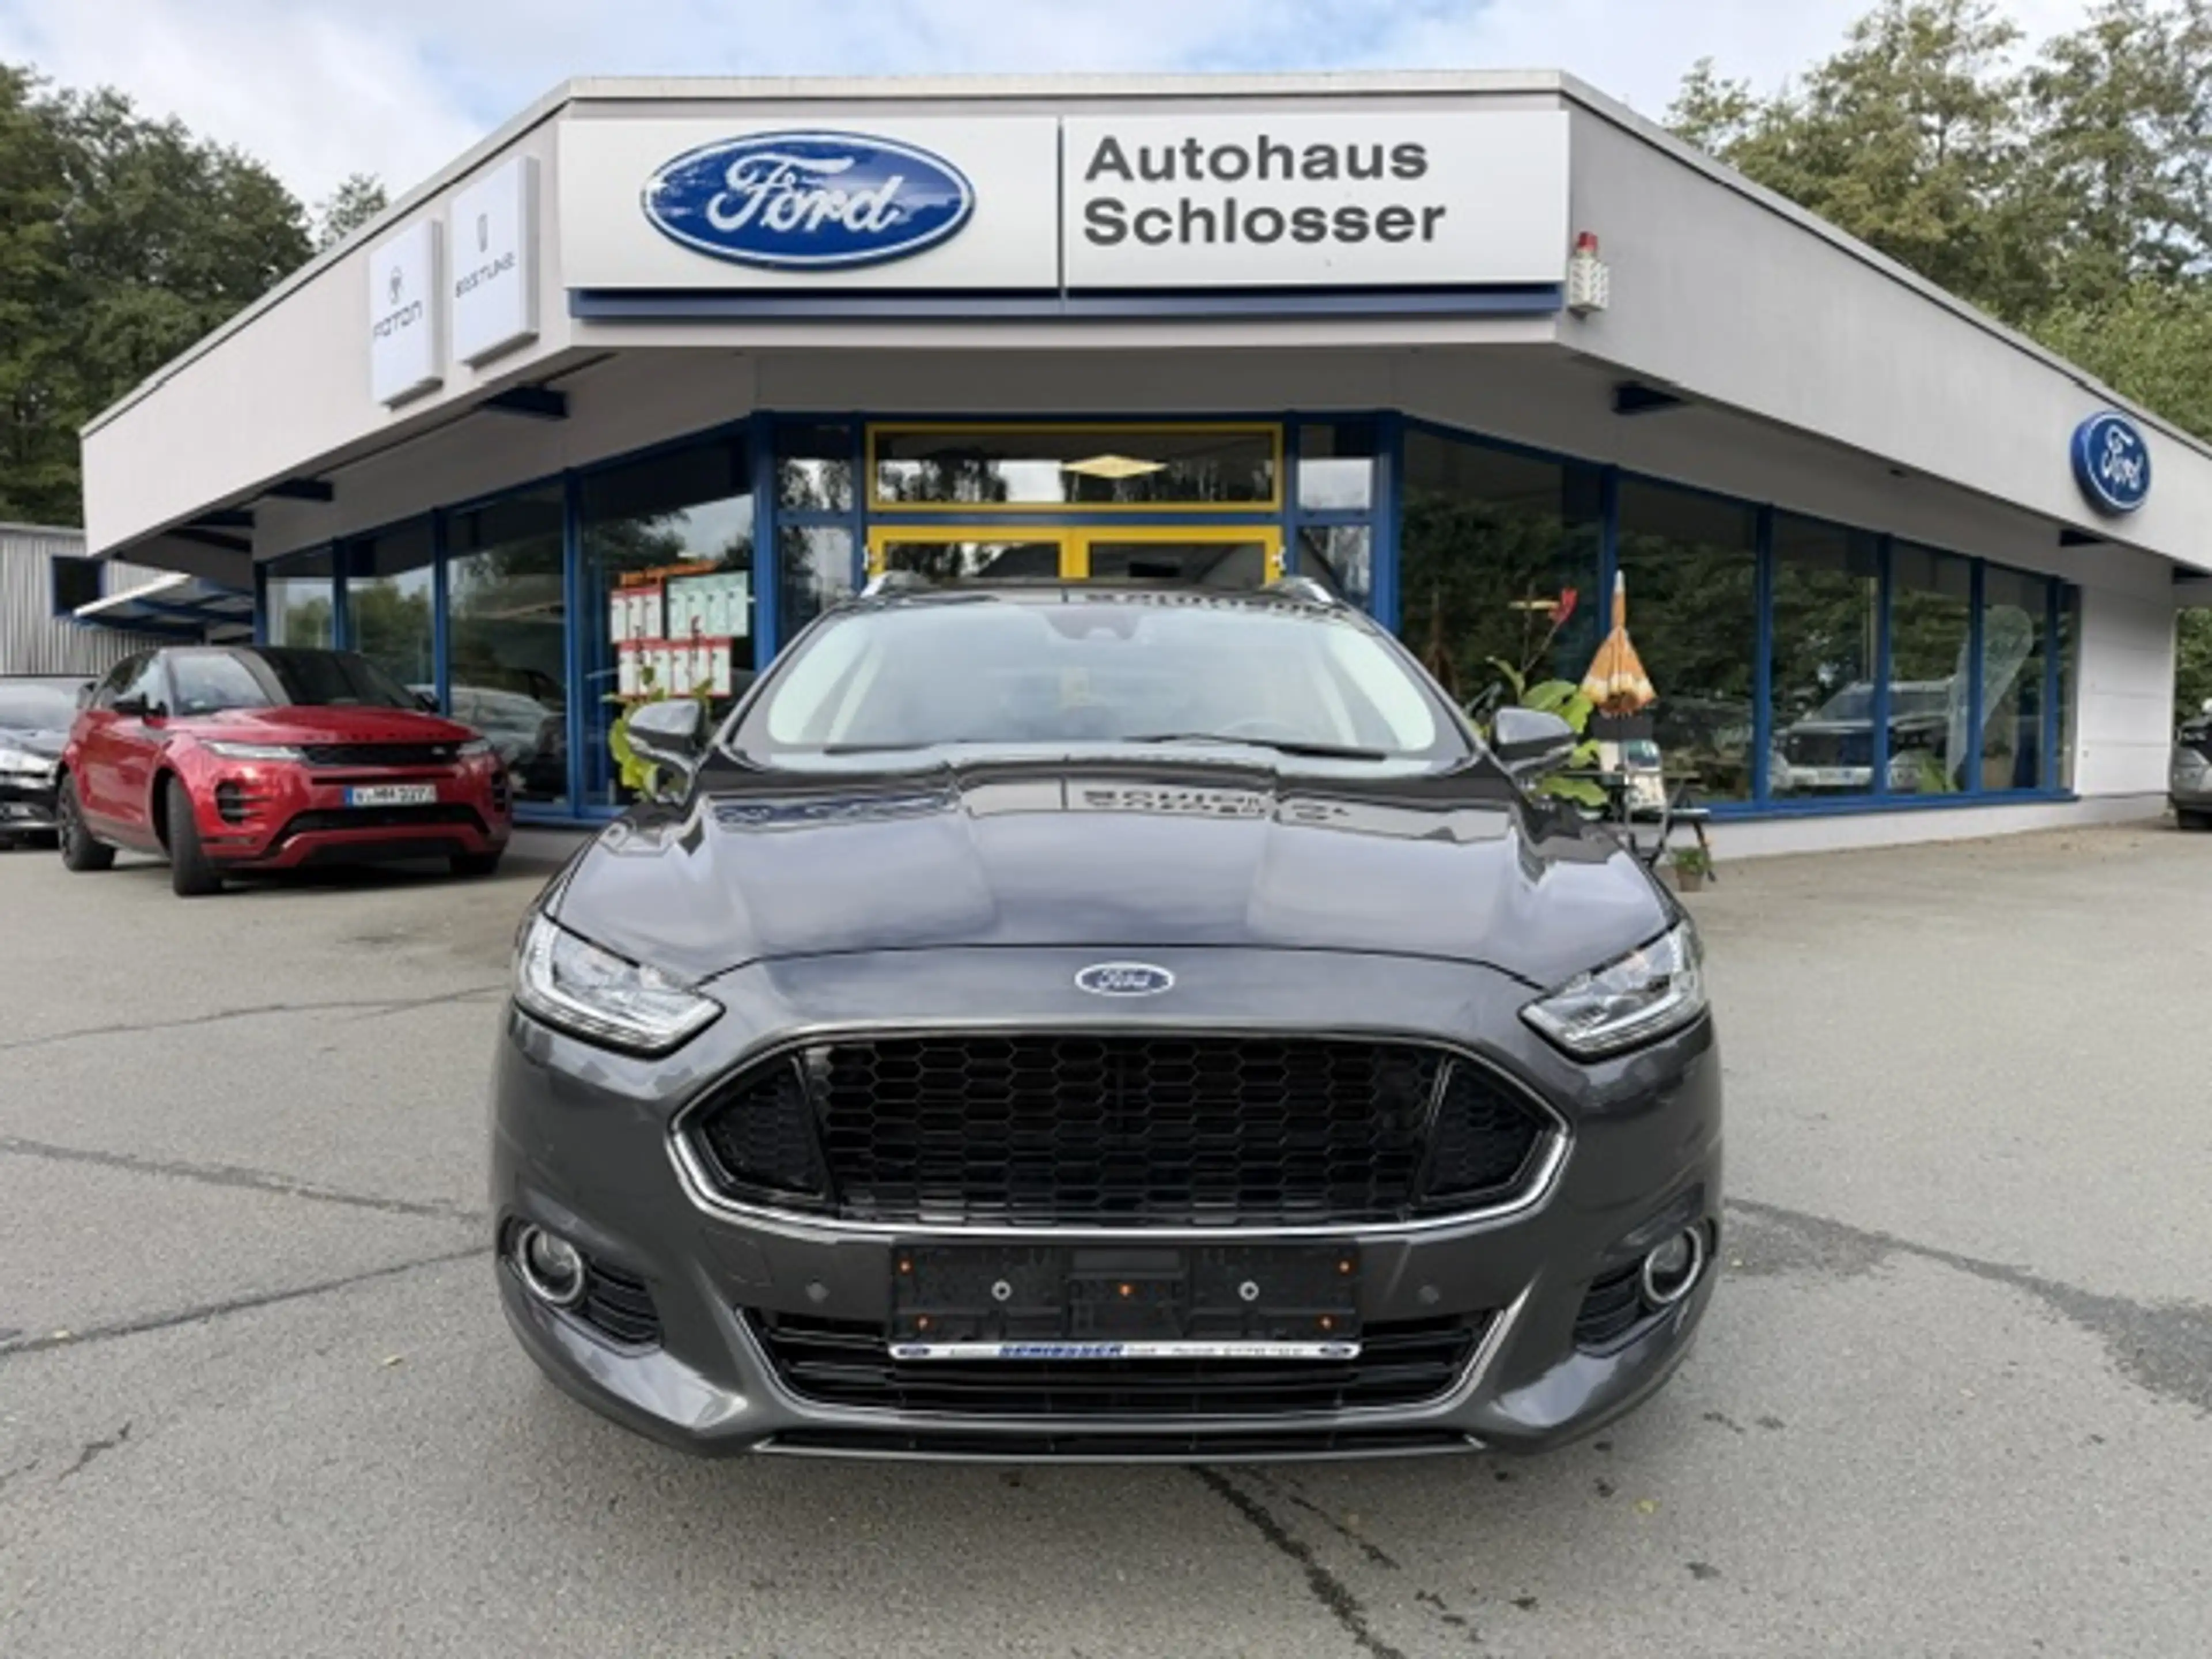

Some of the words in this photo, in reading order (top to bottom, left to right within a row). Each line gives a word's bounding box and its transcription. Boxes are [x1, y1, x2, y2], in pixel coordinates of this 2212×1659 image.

[1084, 134, 1429, 181] Autohaus
[706, 152, 905, 232] Ford
[1084, 197, 1446, 245] Schlosser
[2100, 424, 2143, 491] Ford
